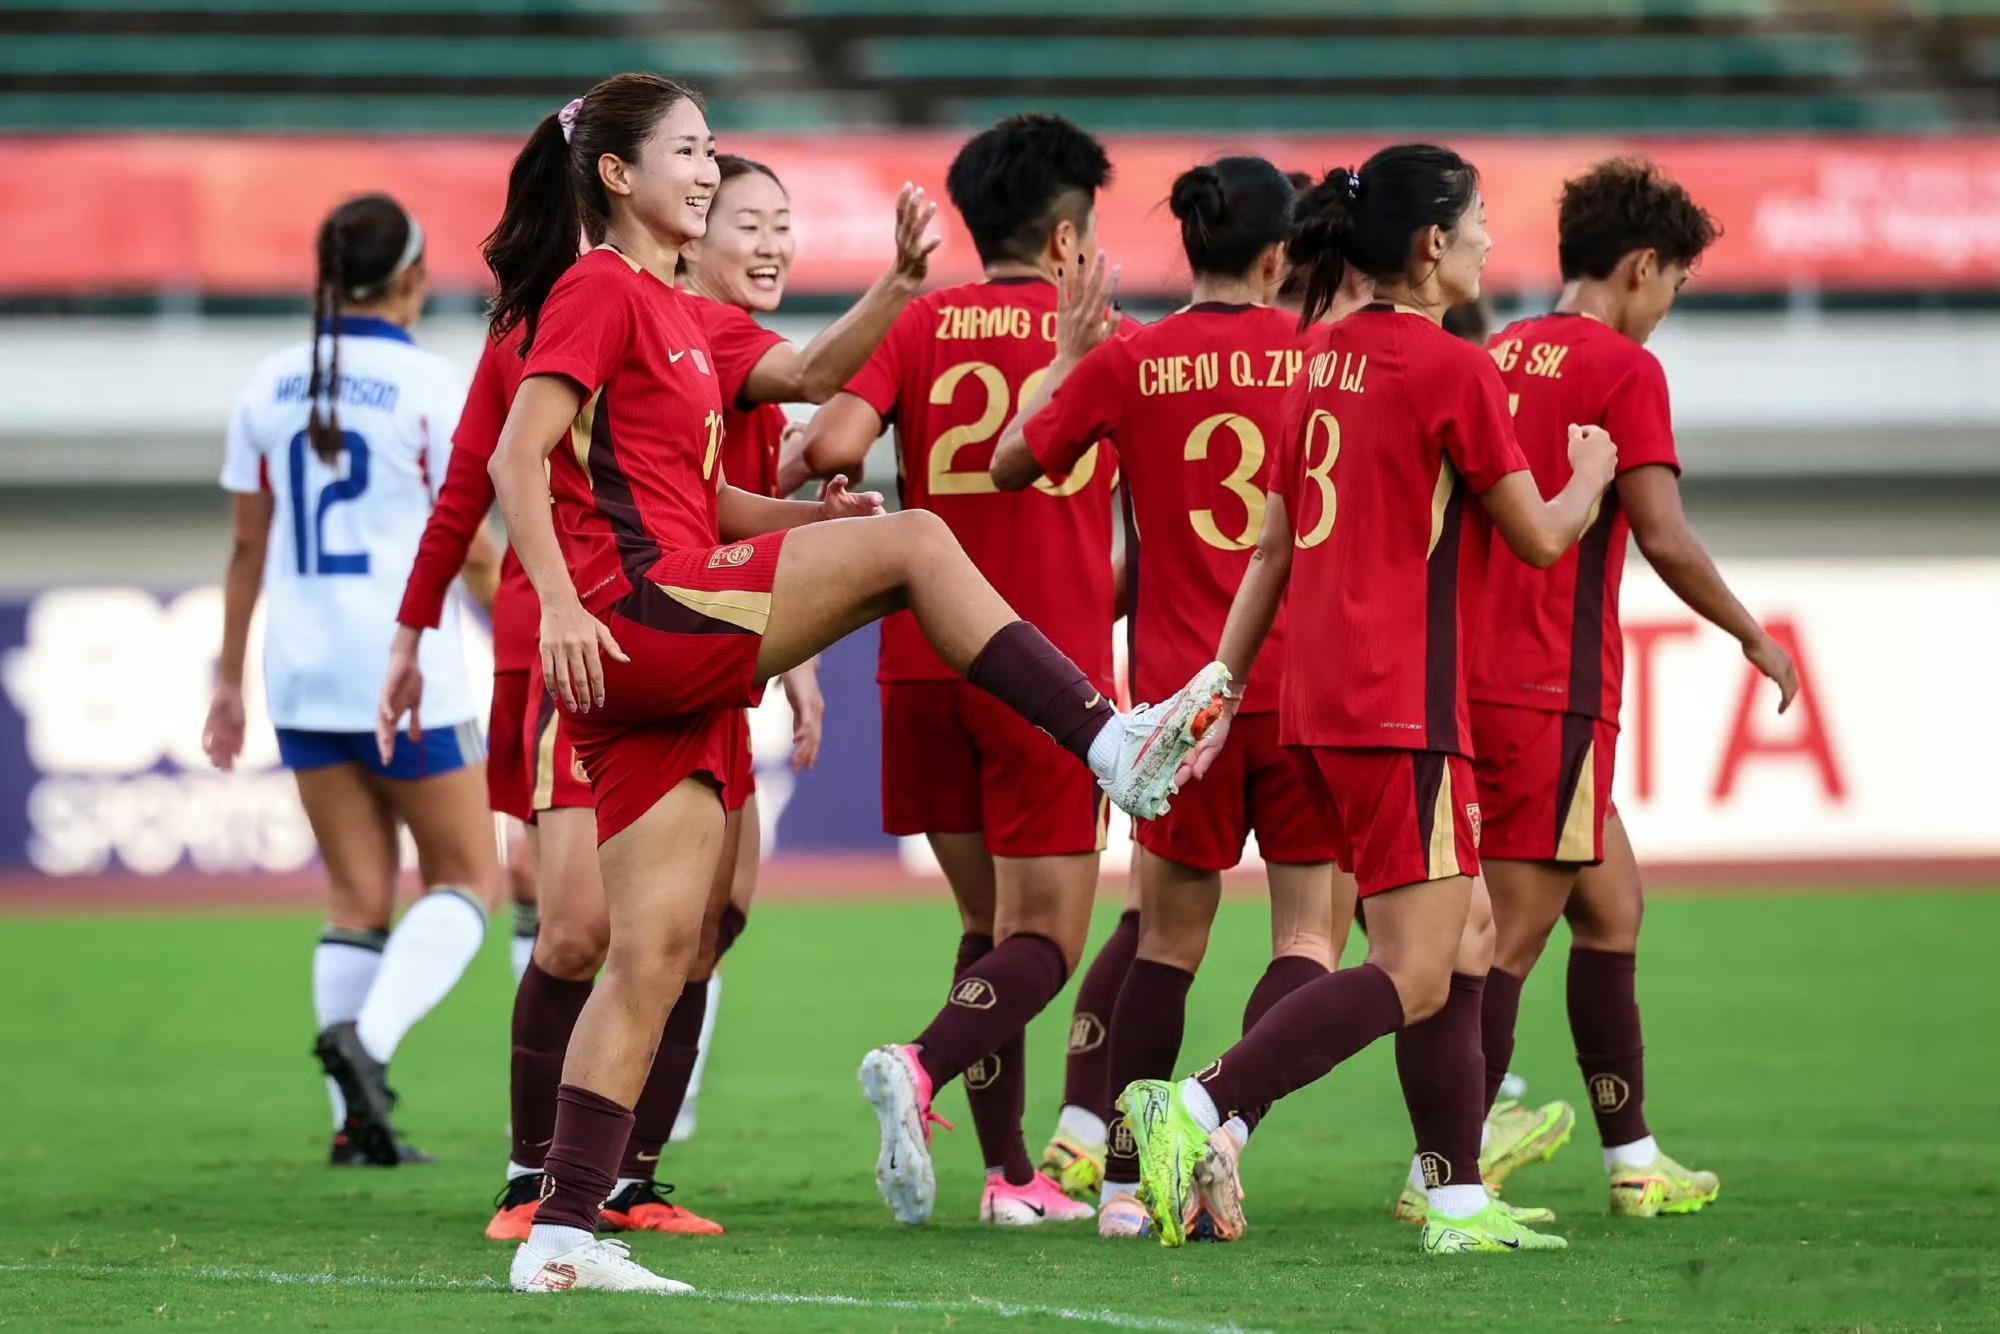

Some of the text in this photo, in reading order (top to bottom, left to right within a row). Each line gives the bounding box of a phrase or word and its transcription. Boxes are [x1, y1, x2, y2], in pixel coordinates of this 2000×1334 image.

[936, 305, 1031, 340] ZHANG
[1138, 351, 1219, 397] CHEN
[289, 428, 370, 575] 12
[1184, 413, 1267, 551] 3
